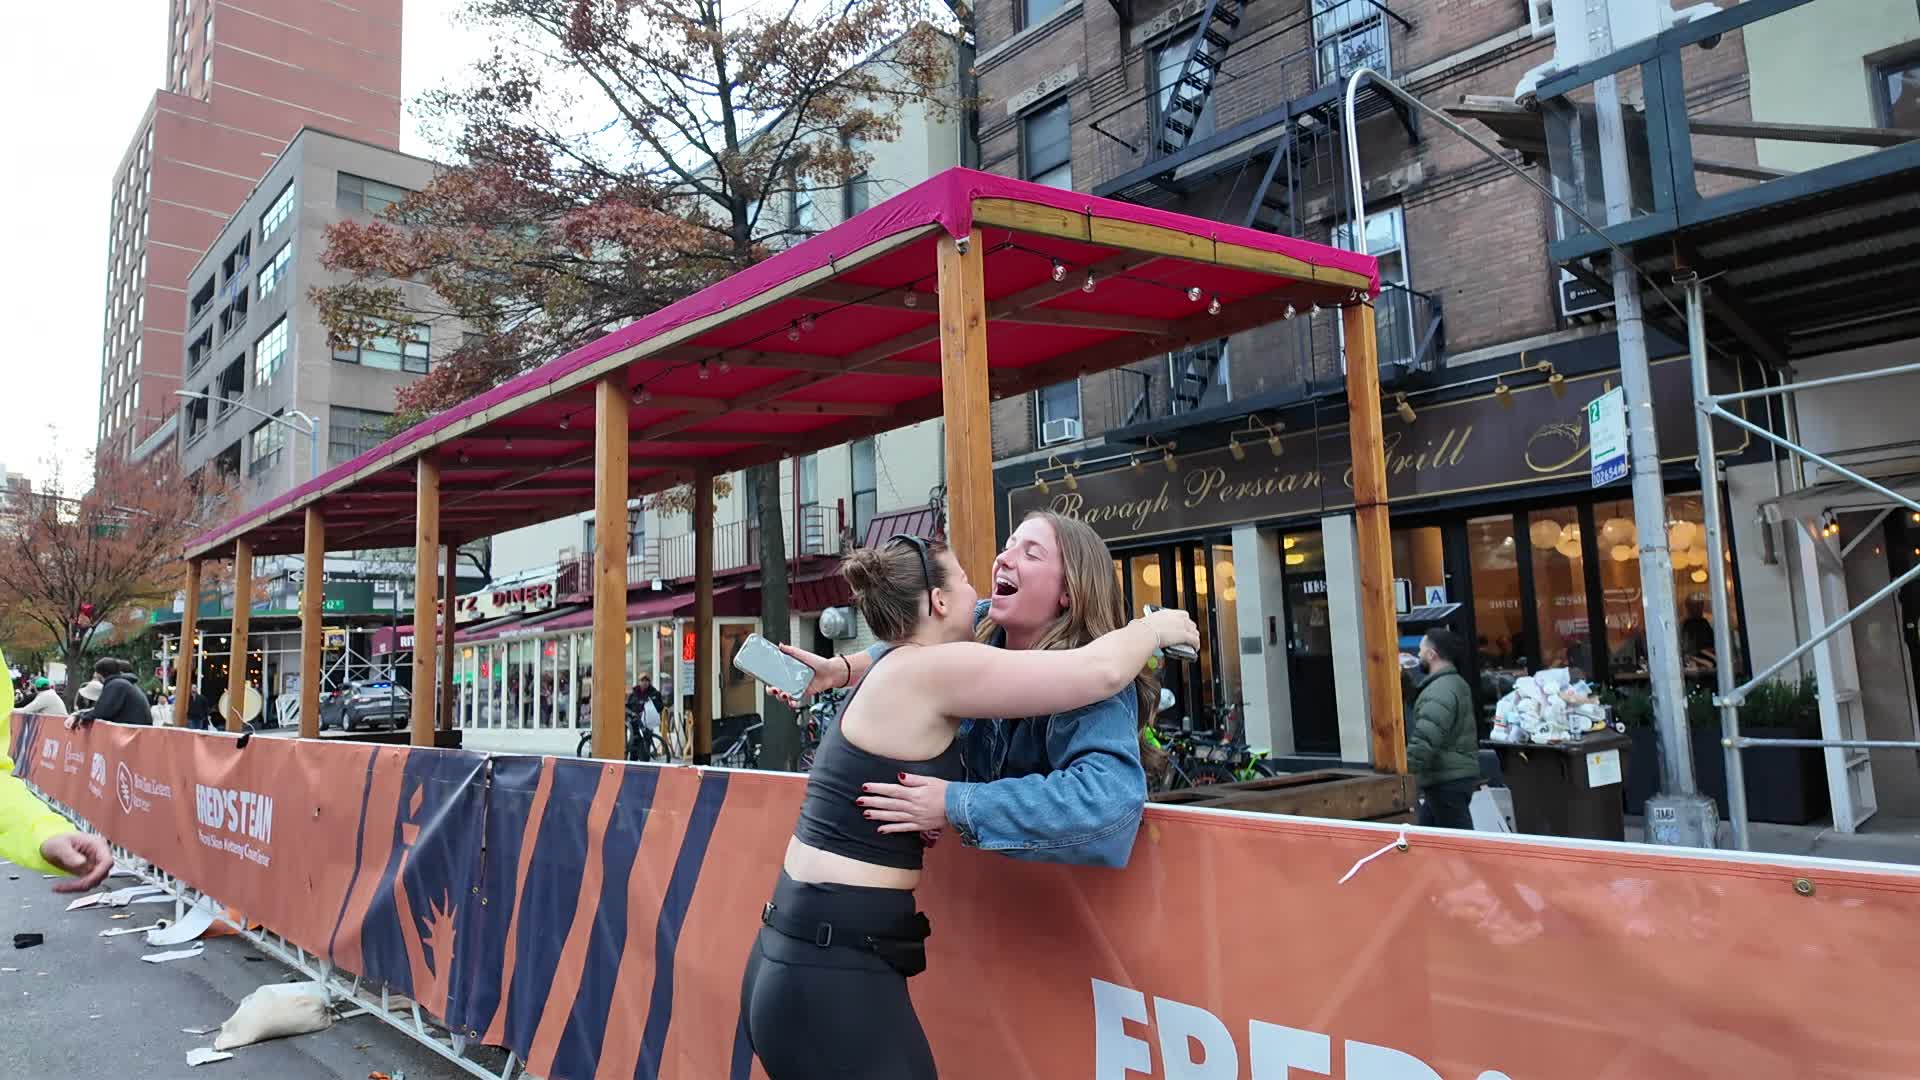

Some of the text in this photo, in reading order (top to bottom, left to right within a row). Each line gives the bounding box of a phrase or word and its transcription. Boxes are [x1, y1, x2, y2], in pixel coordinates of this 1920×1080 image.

[1184, 466, 1326, 509] Persian
[492, 584, 553, 607] DINER
[1430, 589, 1443, 604] A
[239, 790, 273, 845] TEAM
